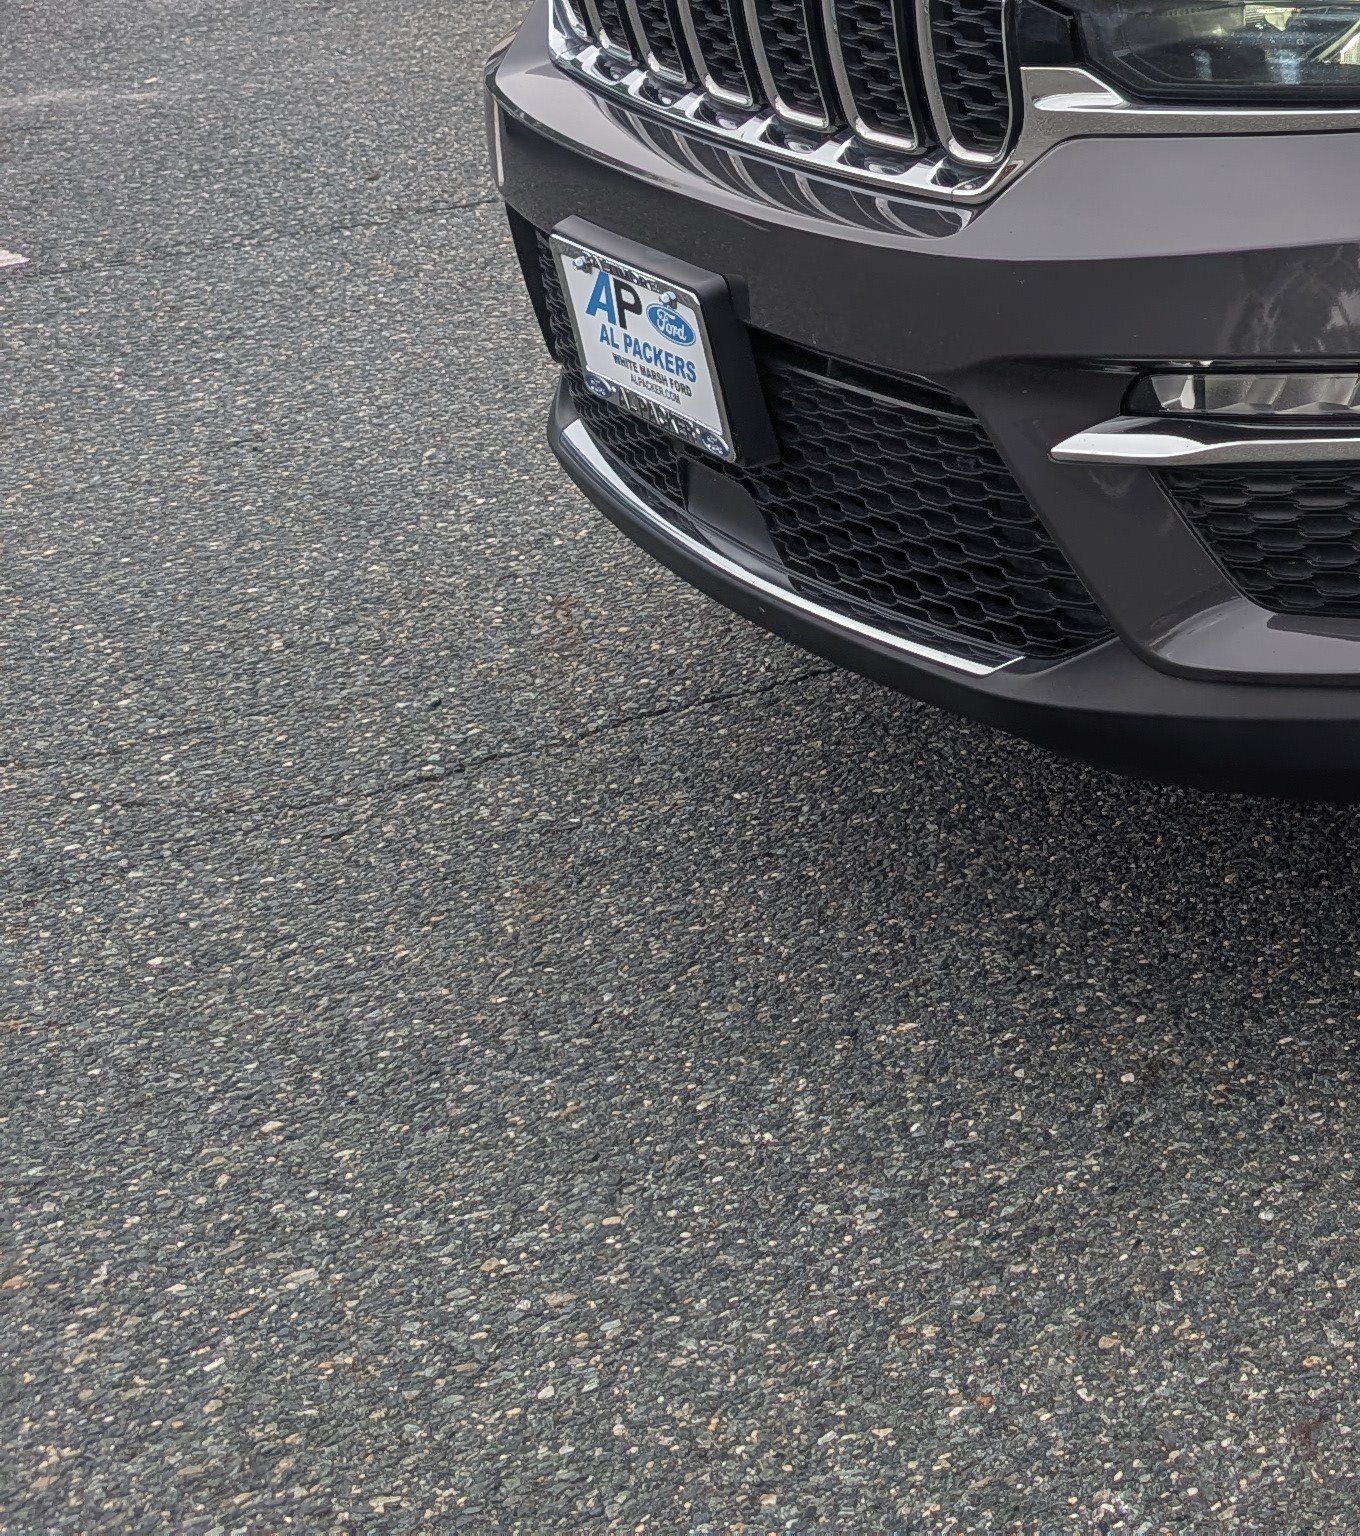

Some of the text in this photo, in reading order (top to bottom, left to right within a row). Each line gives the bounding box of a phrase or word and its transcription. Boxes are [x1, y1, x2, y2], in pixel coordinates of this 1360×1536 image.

[585, 270, 687, 342] AP Ford
[600, 323, 697, 383] AL PACKERS
[611, 352, 692, 399] WHITE MARSH FORD
